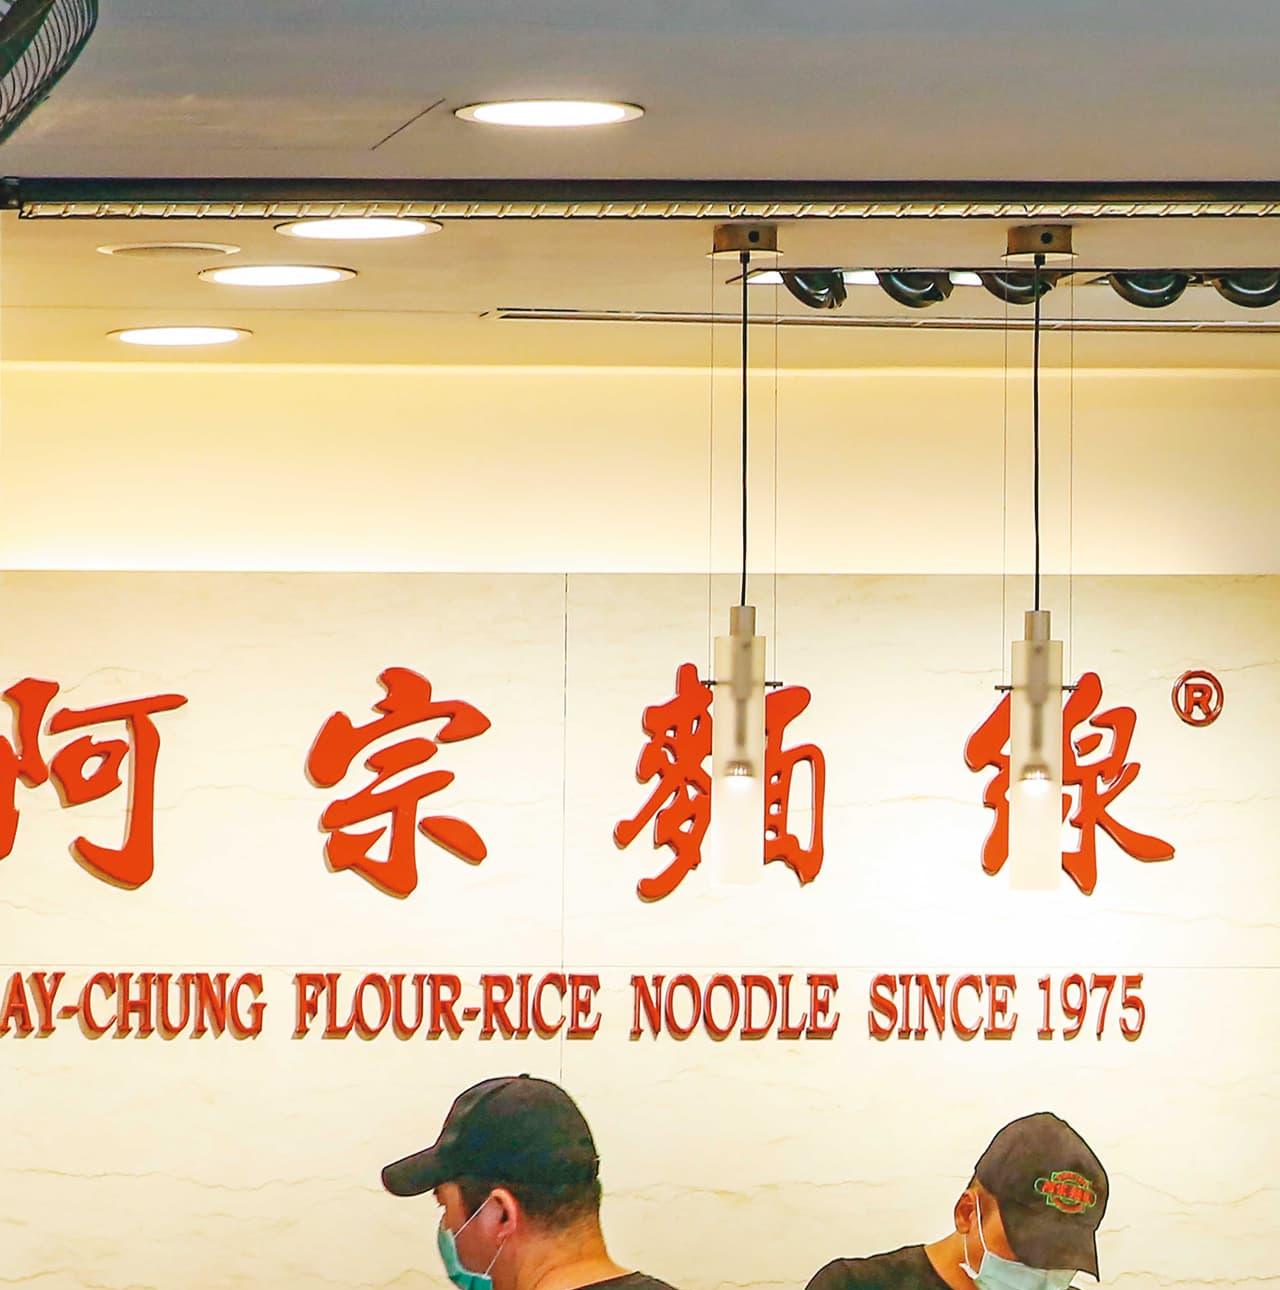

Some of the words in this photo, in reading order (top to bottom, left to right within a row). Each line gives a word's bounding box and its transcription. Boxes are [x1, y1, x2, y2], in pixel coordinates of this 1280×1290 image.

[0, 972, 267, 1040] AY-CHUNG
[291, 973, 602, 1040] FLOUR-RICE
[628, 974, 841, 1041] NOODLE
[868, 974, 1018, 1041] SINCE
[1036, 973, 1147, 1041] 1975
